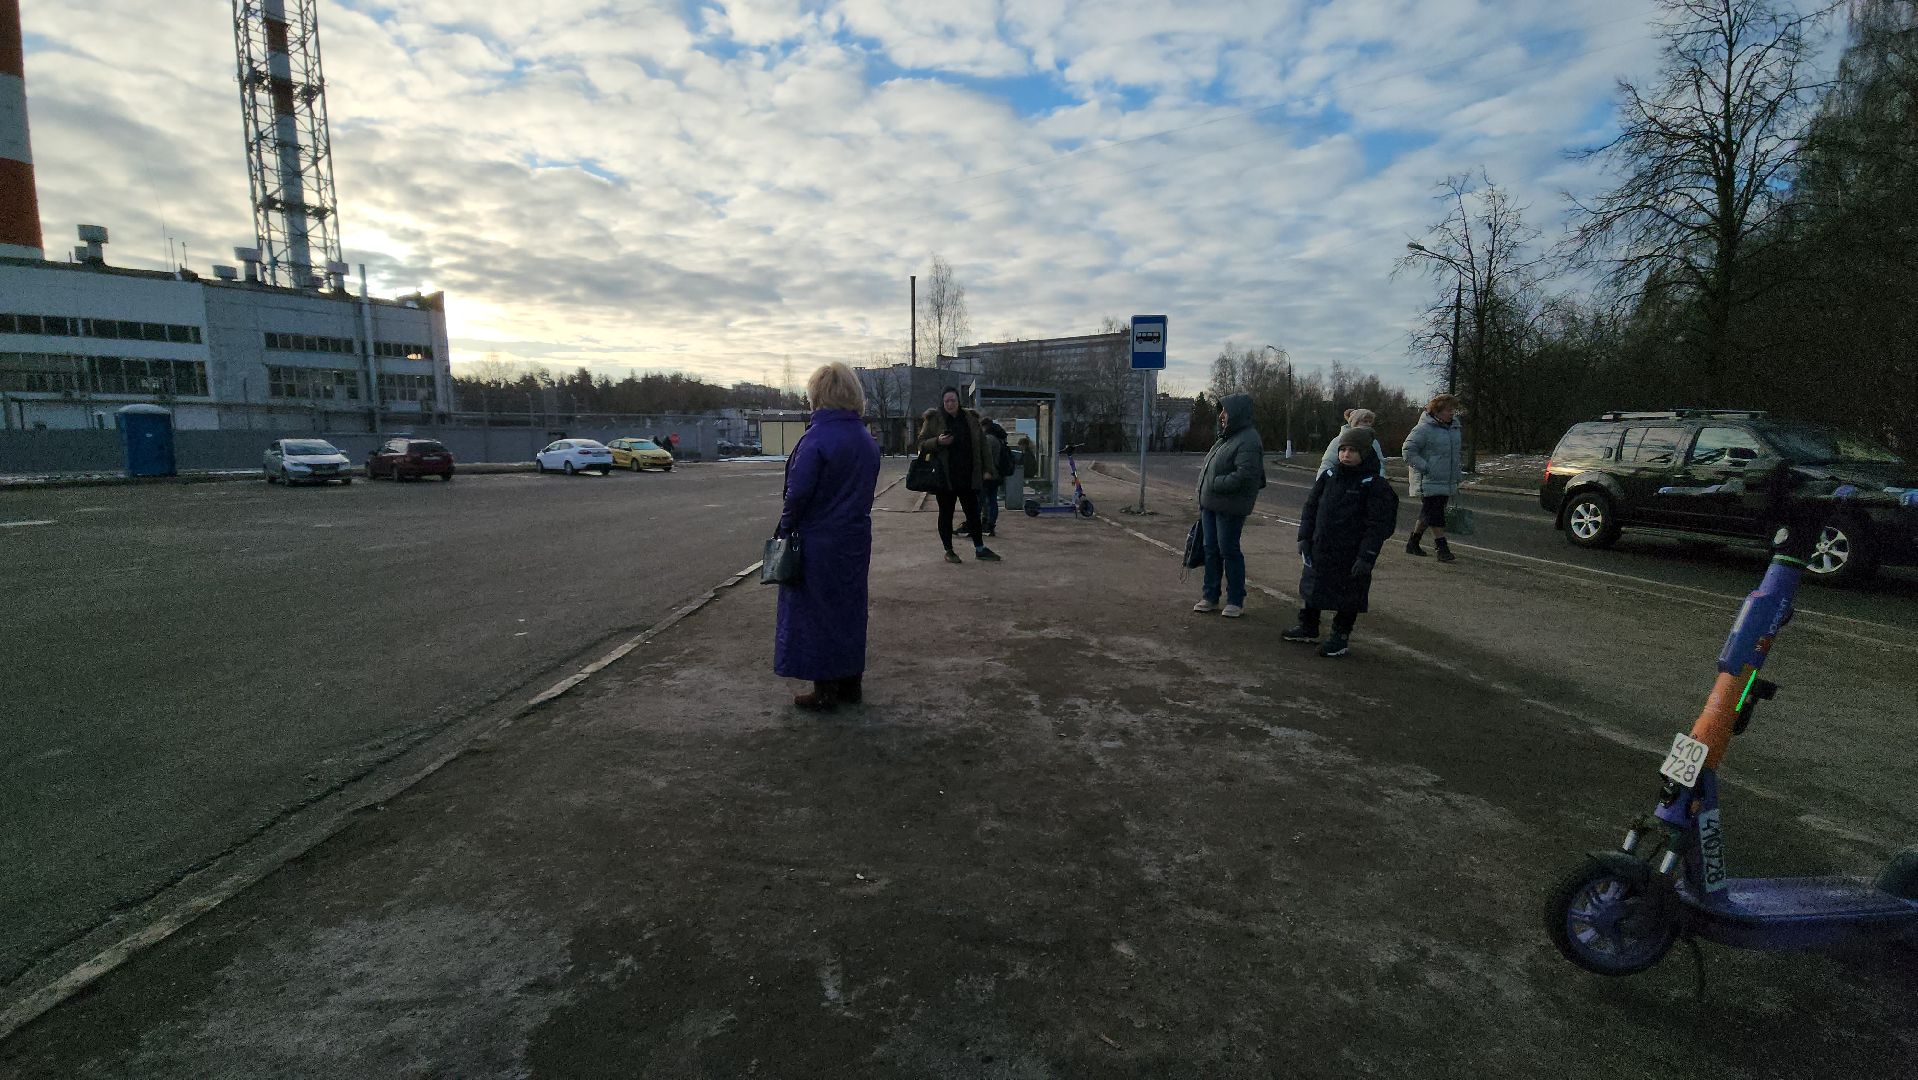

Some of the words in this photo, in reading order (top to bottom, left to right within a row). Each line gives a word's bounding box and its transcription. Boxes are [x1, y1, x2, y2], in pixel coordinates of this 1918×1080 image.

[1675, 738, 1703, 764] 410
[1665, 754, 1696, 783] 728
[1702, 818, 1725, 885] 410728
